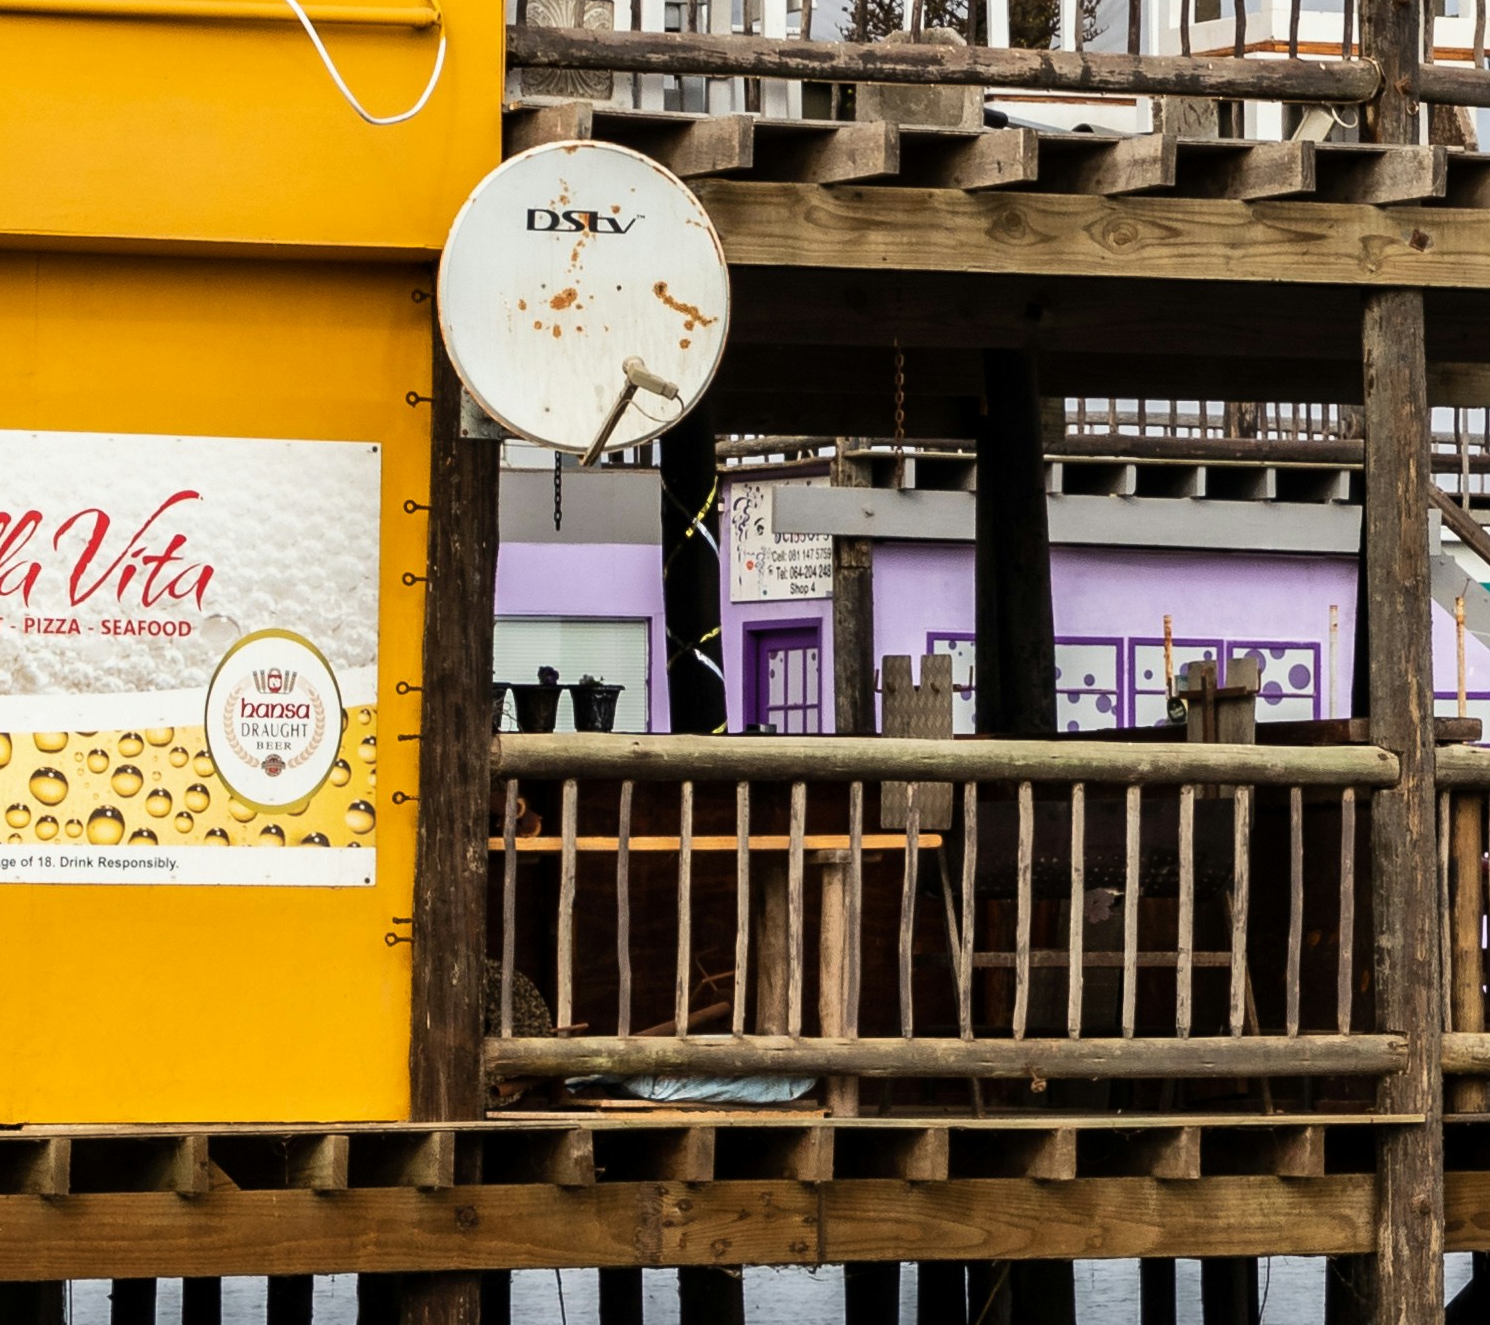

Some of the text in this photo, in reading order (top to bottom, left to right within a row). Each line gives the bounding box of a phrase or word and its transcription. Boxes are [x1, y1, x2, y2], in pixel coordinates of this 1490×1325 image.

[527, 208, 636, 234] DStv
[52, 489, 214, 611] Vita
[790, 581, 816, 596] Shop 4
[24, 617, 81, 635] PIZZA
[100, 619, 192, 637] SEAFOOD
[241, 697, 310, 719] hansa
[241, 722, 308, 738] DRAUGHT
[256, 741, 292, 751] BEER
[20, 856, 33, 867] of
[38, 857, 55, 867] 18.
[60, 856, 93, 868] Drink
[98, 857, 179, 871] Responsibly.
